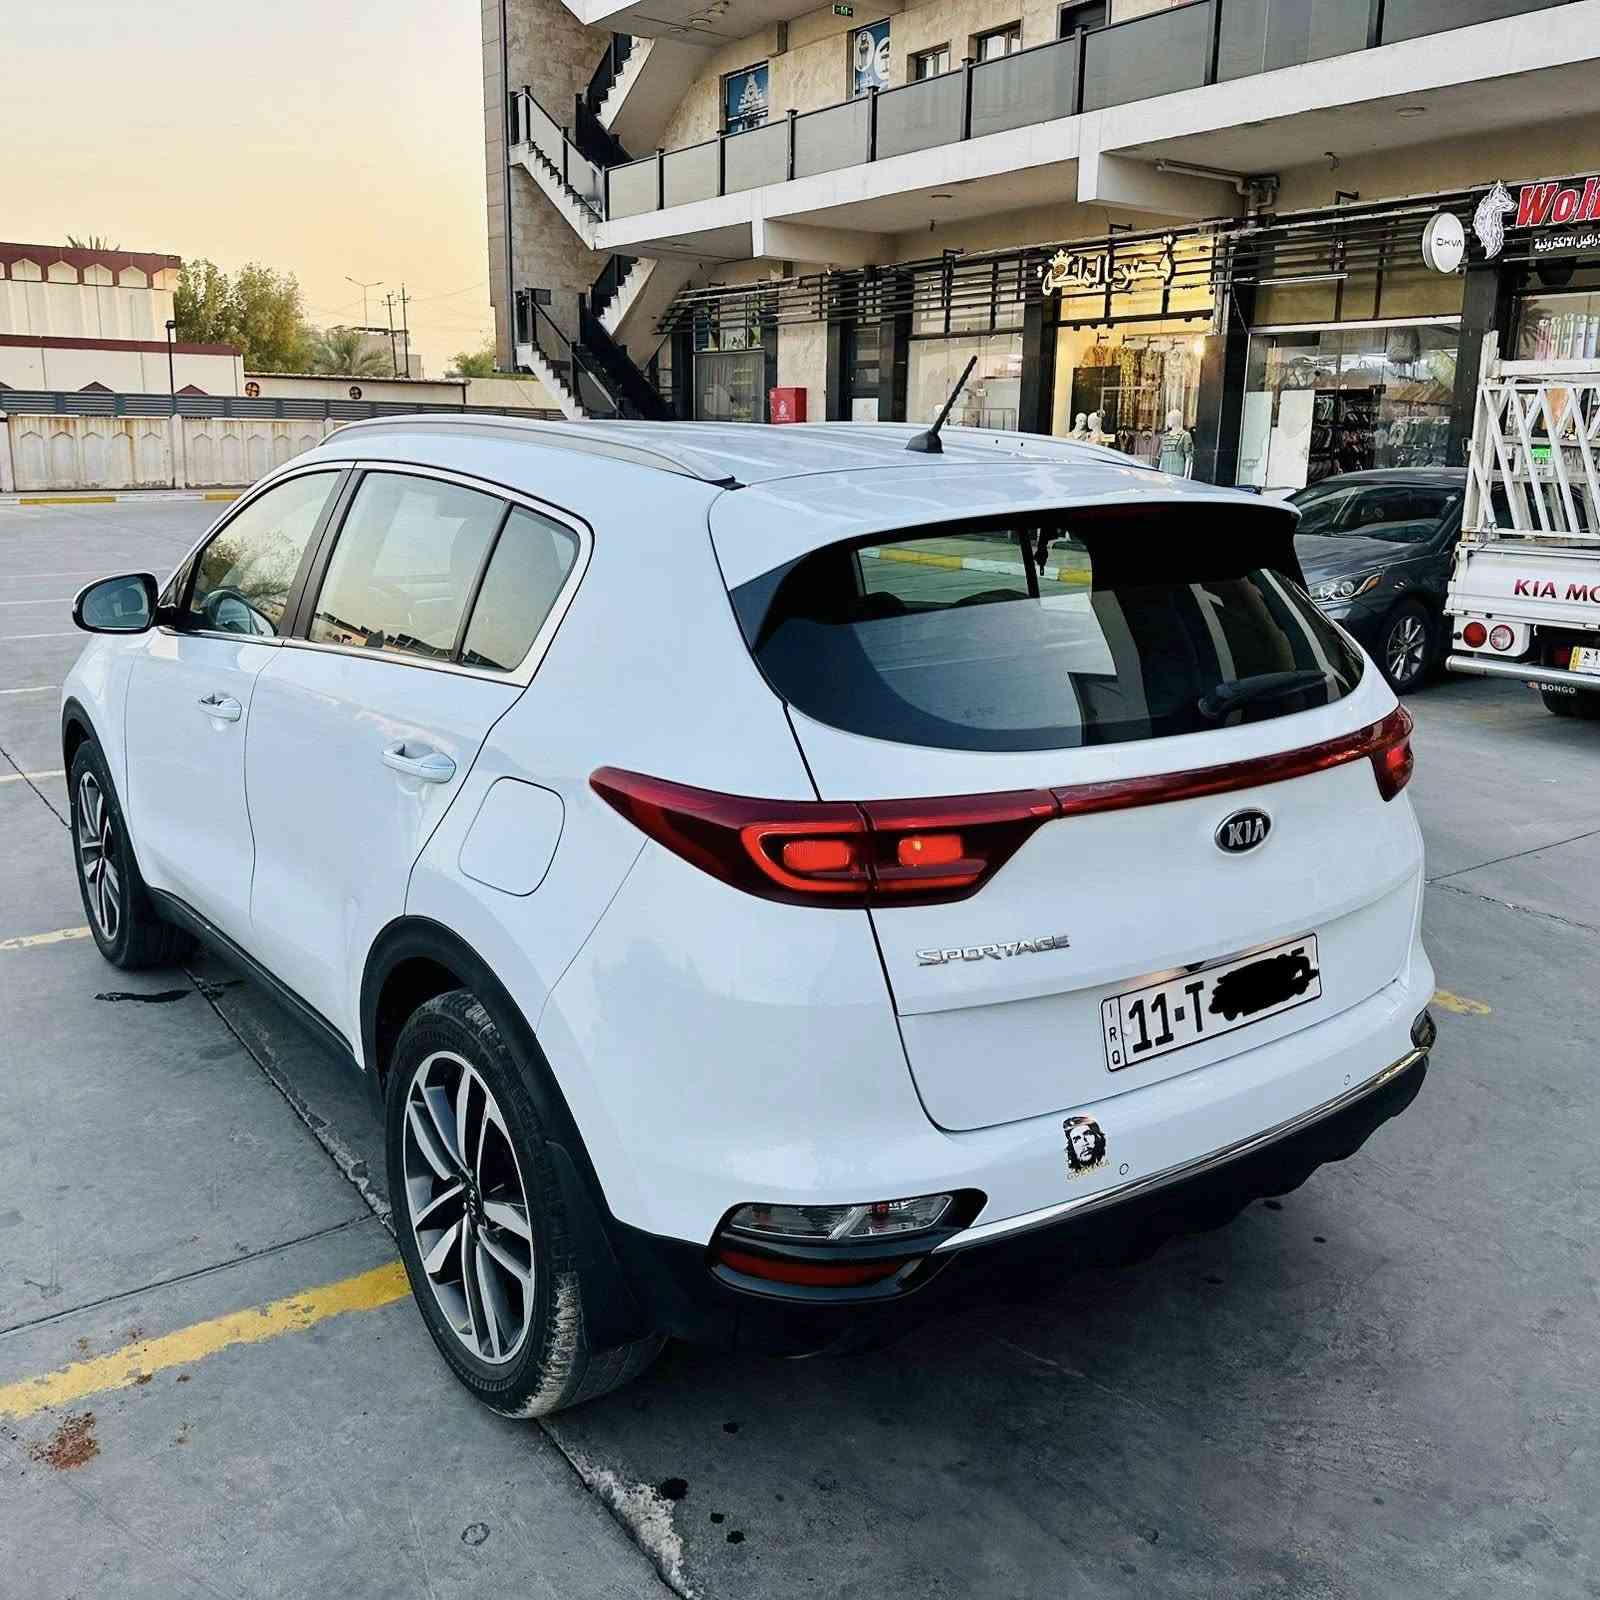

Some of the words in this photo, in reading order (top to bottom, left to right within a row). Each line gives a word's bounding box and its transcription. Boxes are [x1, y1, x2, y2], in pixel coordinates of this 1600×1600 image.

[1514, 579, 1557, 599] KIA
[1541, 683, 1576, 695] BONGO
[1228, 817, 1265, 847] KIA
[915, 935, 1070, 967] SPORTAGE
